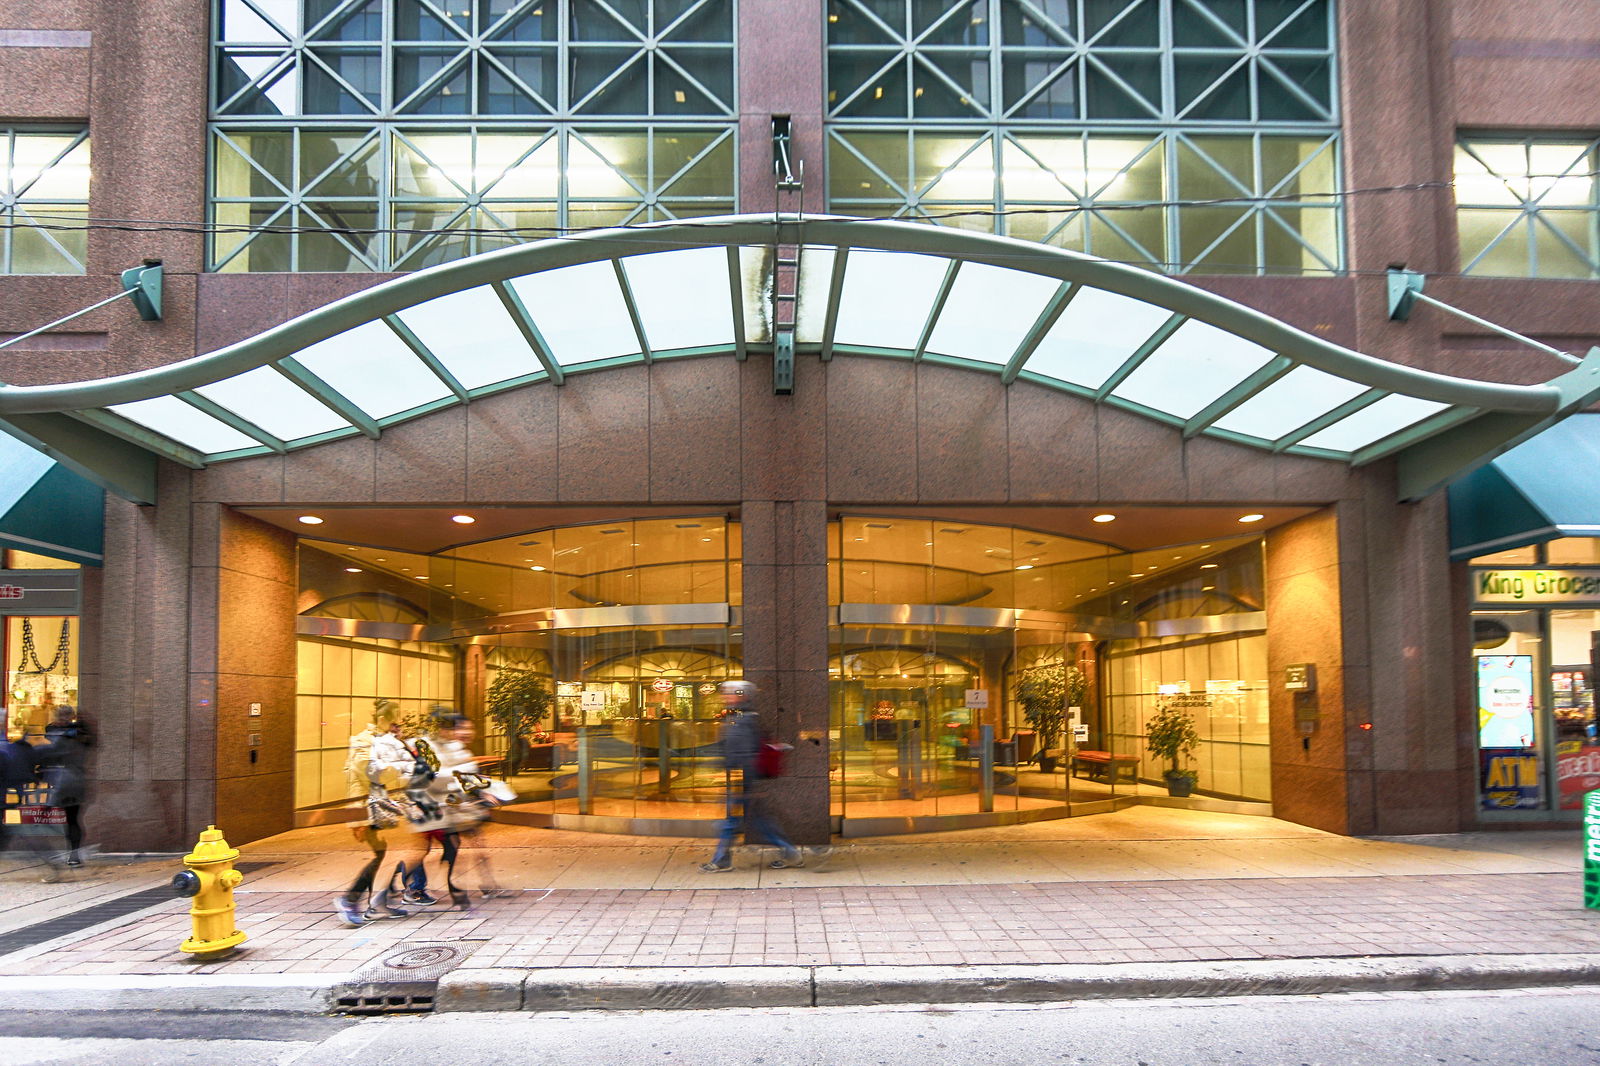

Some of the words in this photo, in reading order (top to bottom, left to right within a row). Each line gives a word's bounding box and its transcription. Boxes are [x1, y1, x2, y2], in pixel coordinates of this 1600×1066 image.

[1479, 572, 1524, 598] King
[591, 693, 596, 702] 7
[1487, 757, 1538, 787] ATM
